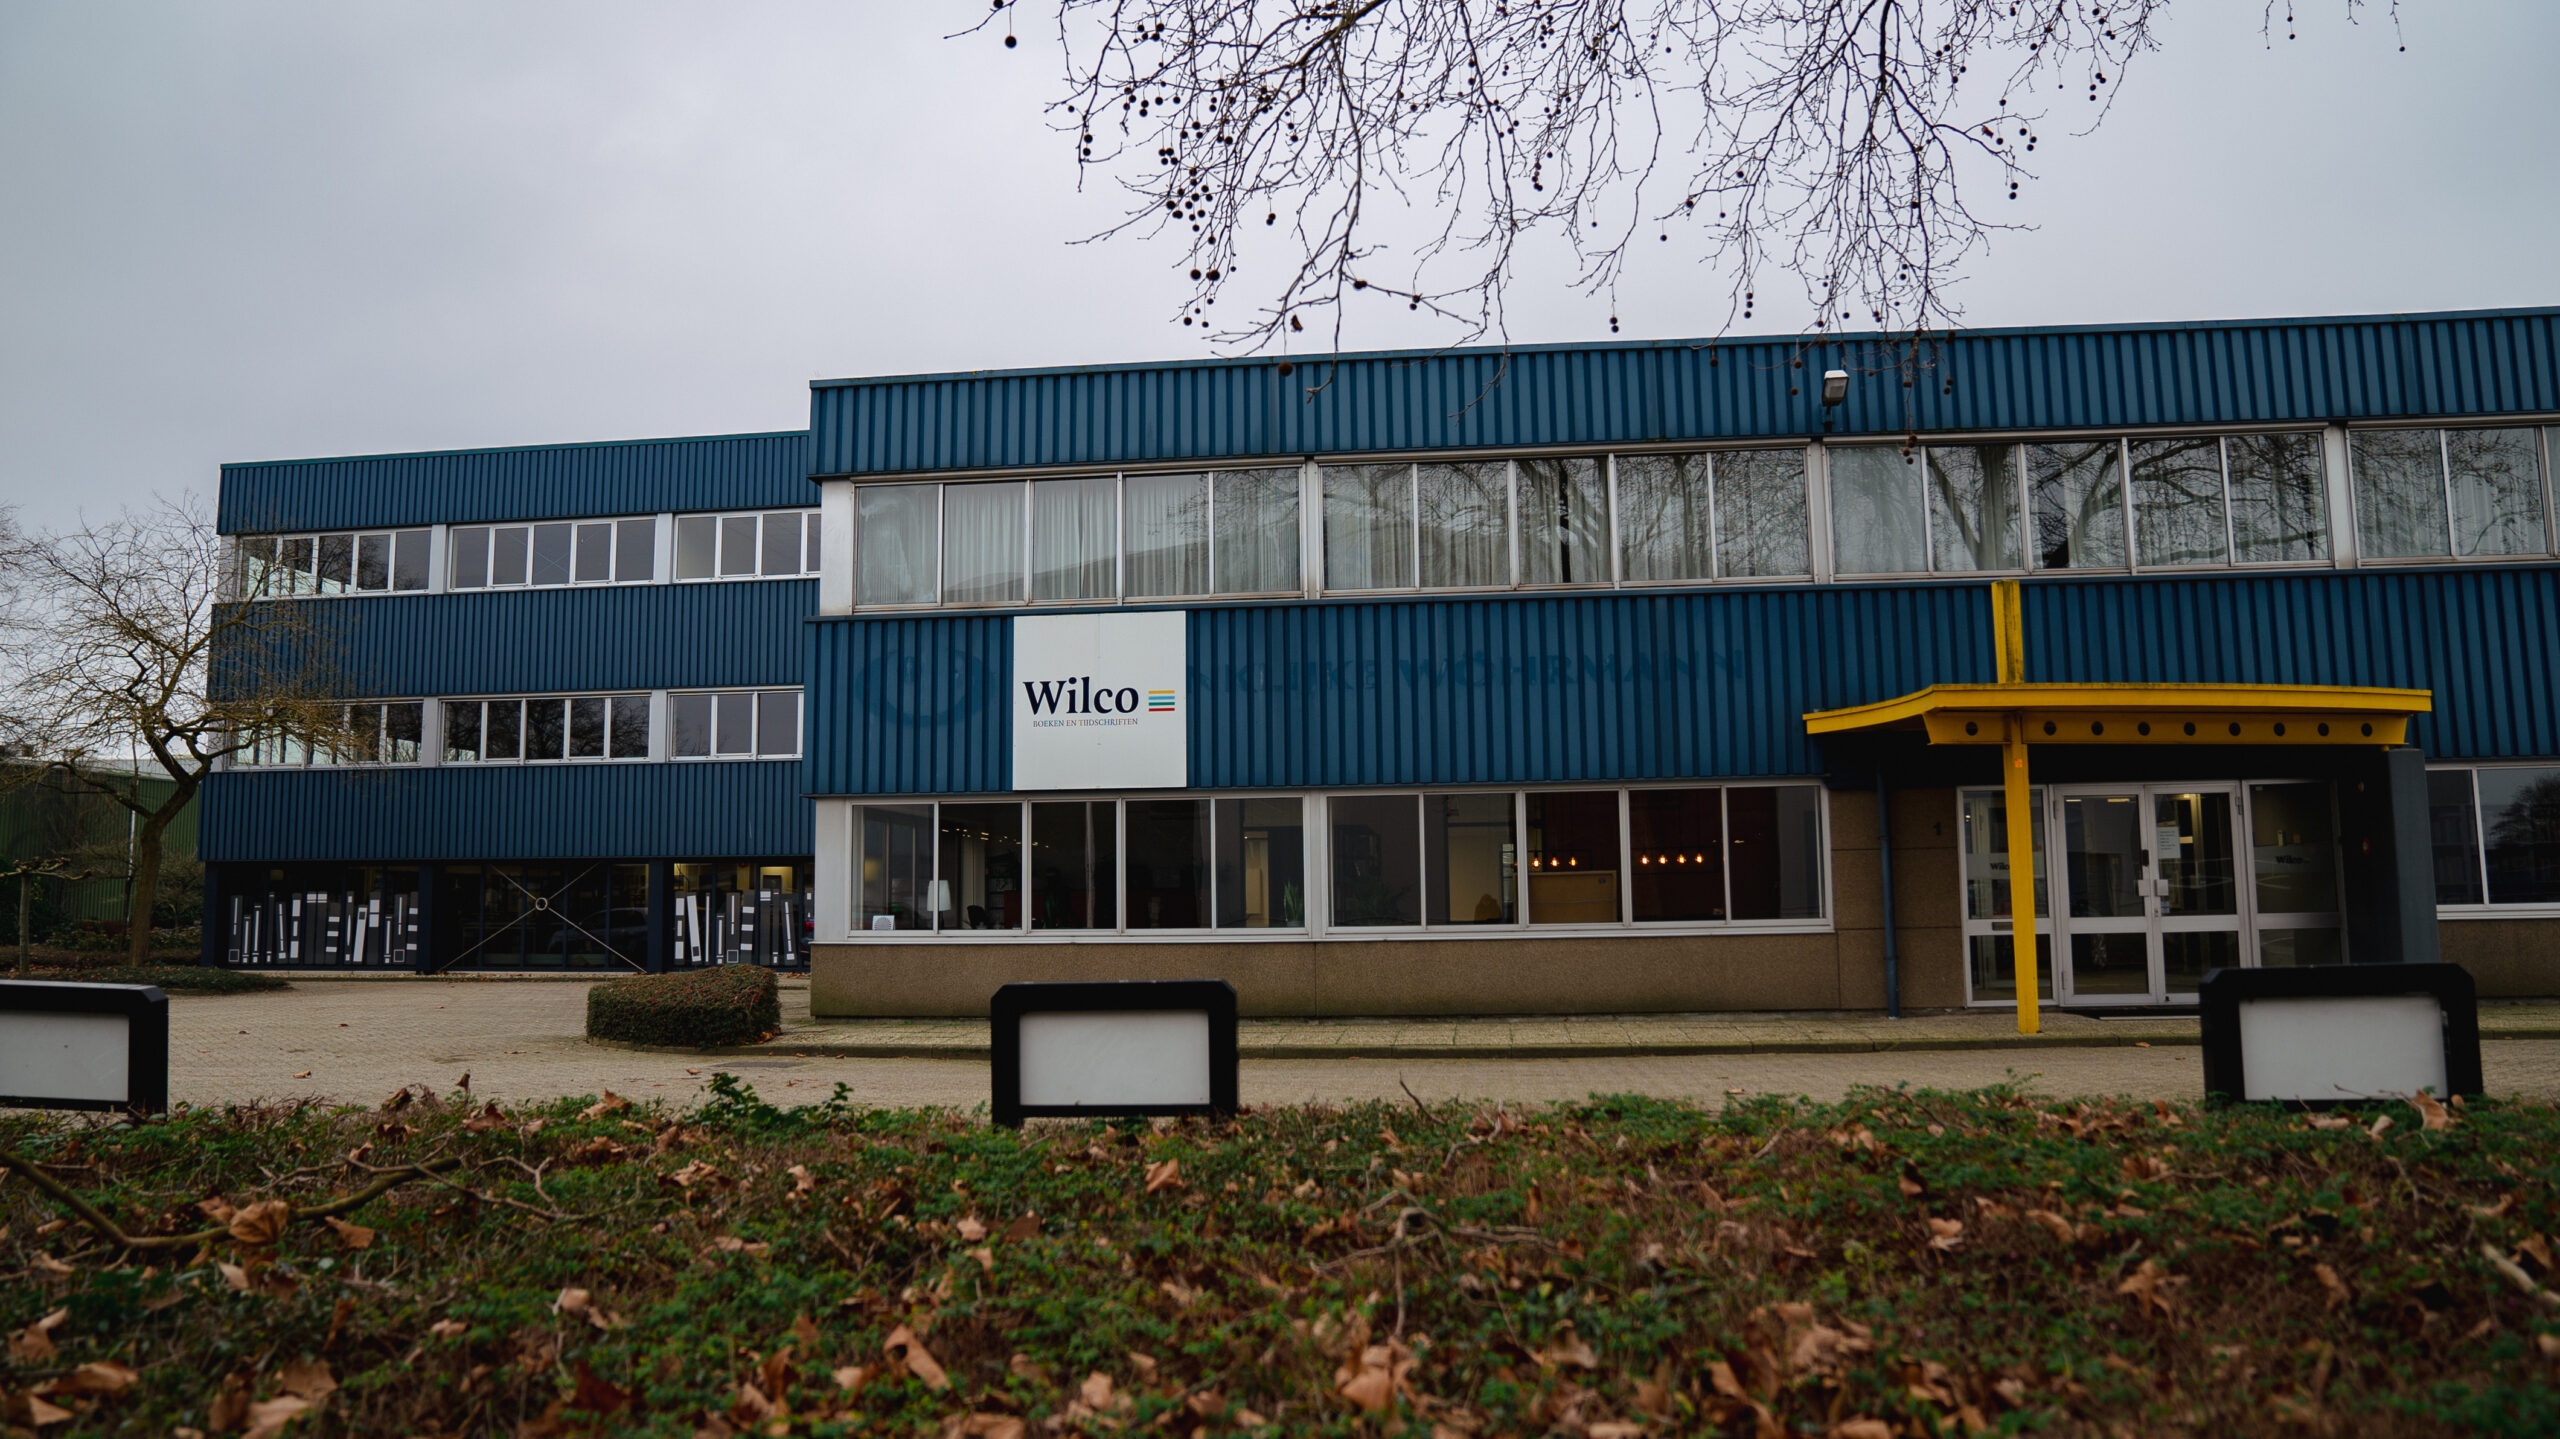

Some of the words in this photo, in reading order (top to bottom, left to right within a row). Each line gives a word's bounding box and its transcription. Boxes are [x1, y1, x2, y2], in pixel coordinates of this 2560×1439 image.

[1022, 676, 1139, 715] Wilco
[1033, 719, 1065, 728] BOEKEN
[1066, 719, 1077, 727] EN
[1990, 862, 2009, 870] Wilc
